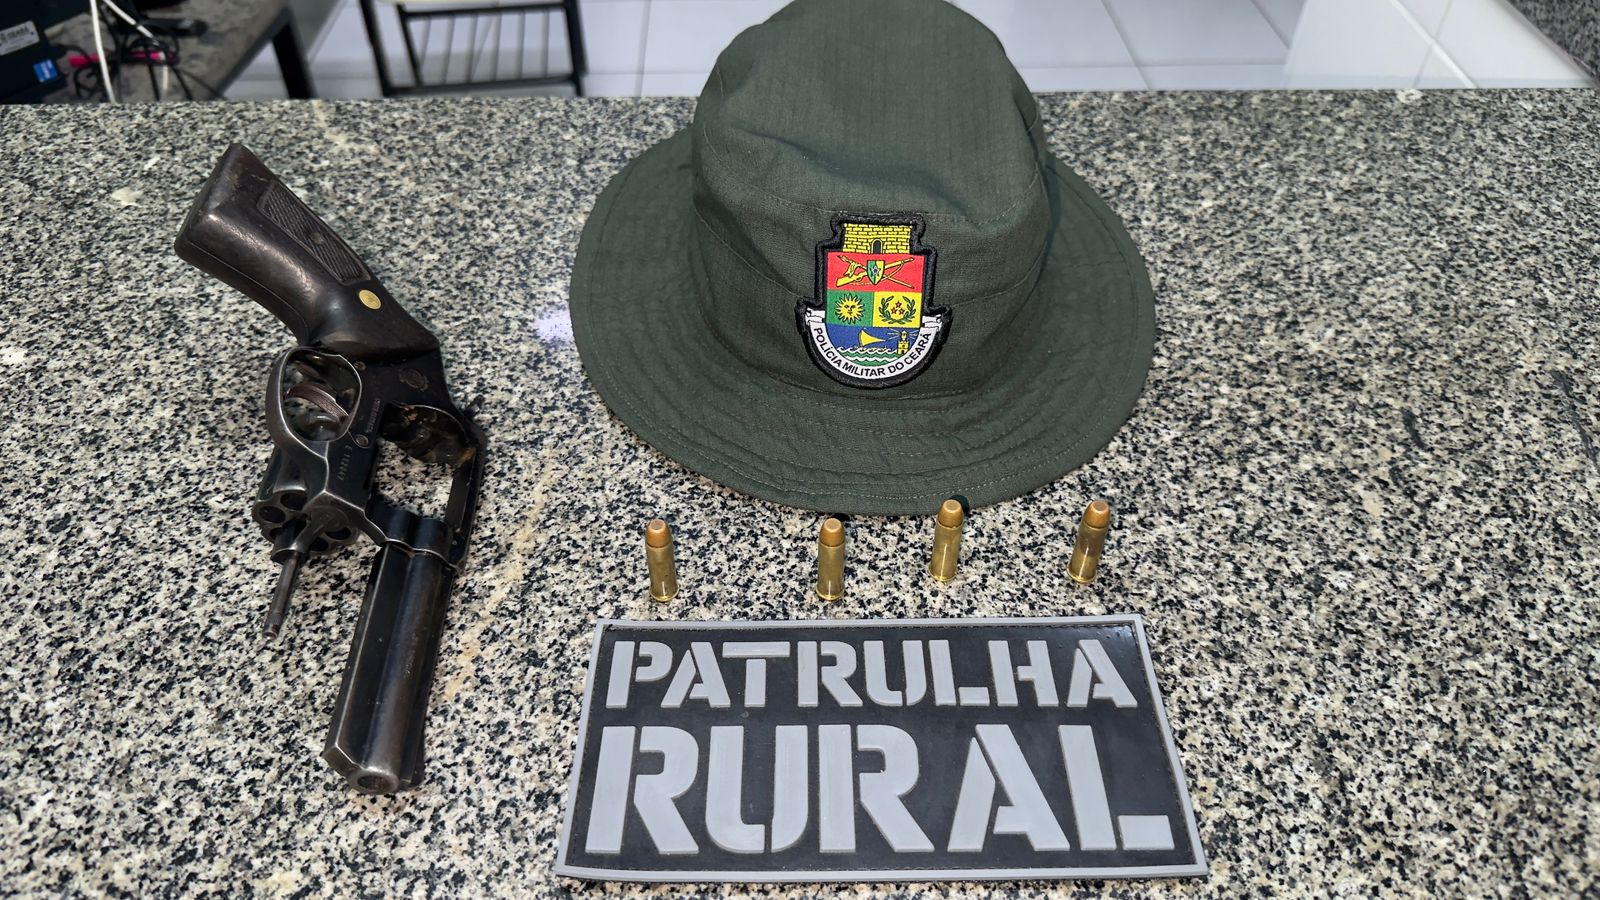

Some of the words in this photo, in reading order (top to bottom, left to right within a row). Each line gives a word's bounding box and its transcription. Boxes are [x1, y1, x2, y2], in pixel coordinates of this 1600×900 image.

[813, 327, 841, 366] POLÍCIA
[842, 362, 886, 377] MILITAR
[889, 362, 905, 374] DO
[904, 332, 932, 365] CEARÁ
[605, 639, 1138, 709] PATRULHA
[585, 723, 1175, 855] RURAL
